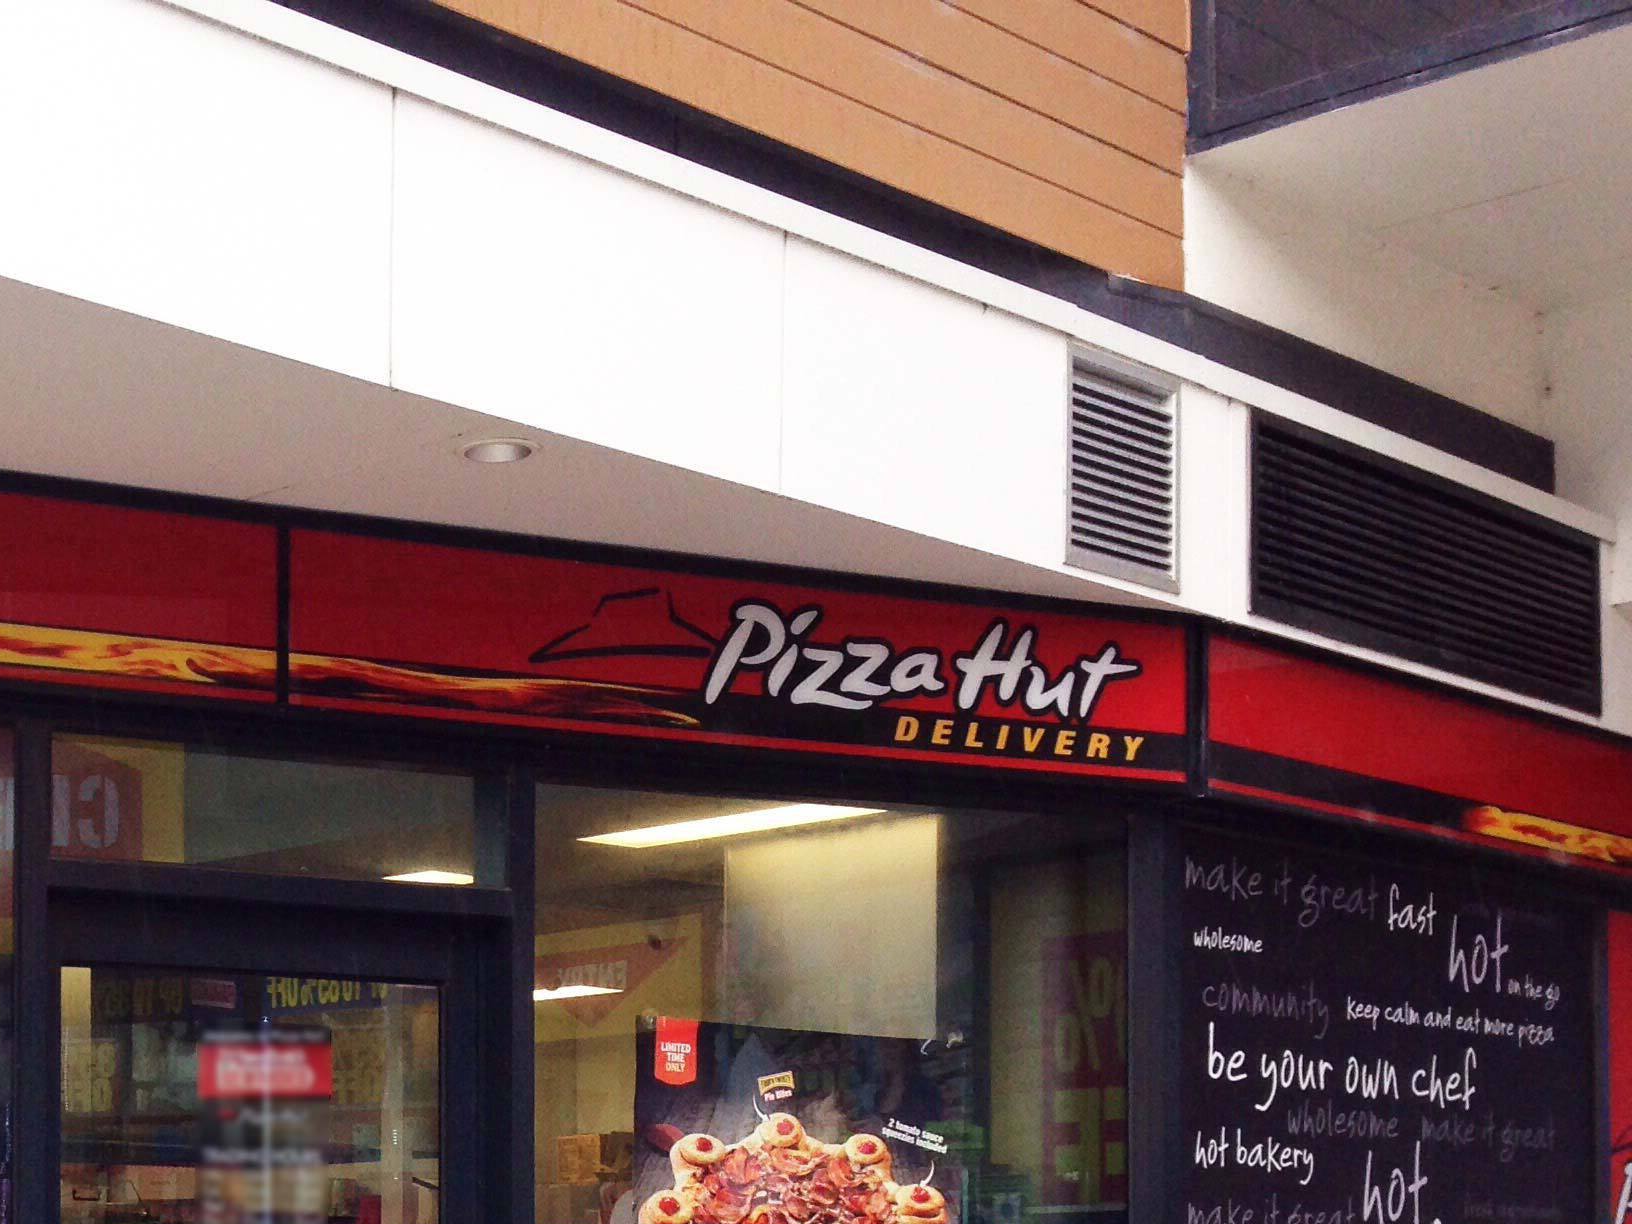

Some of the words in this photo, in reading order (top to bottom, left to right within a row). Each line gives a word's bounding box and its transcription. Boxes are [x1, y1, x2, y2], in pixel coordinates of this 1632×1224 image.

[705, 604, 944, 710] Pizza
[955, 623, 1140, 718] Hut
[894, 716, 1145, 762] DELIVERY
[1184, 856, 1263, 901] make
[1273, 863, 1294, 905] it
[1297, 874, 1378, 928] great
[1388, 882, 1438, 936] fast
[1193, 926, 1263, 953] wholesome
[1447, 908, 1510, 994] hot
[1201, 980, 1330, 1040] community
[1384, 1001, 1421, 1027] calm
[1423, 1006, 1451, 1031] and
[1455, 1009, 1480, 1034] eat
[1483, 1015, 1515, 1038] more
[1517, 1020, 1556, 1047] pizza
[661, 1042, 691, 1053] LIMITED
[665, 1062, 685, 1072] ONLY
[667, 1052, 685, 1063] TIME
[1207, 1021, 1248, 1082] be
[1254, 1048, 1334, 1112] your
[1344, 1057, 1400, 1101] own
[1411, 1047, 1478, 1111] chef
[888, 1118, 895, 1128] 2
[895, 1120, 921, 1136] tomato
[921, 1130, 944, 1143] sauce
[1287, 1101, 1400, 1139] wholesome
[915, 1136, 948, 1154] included
[1194, 1126, 1230, 1170] hot
[1235, 1128, 1315, 1185] bakery
